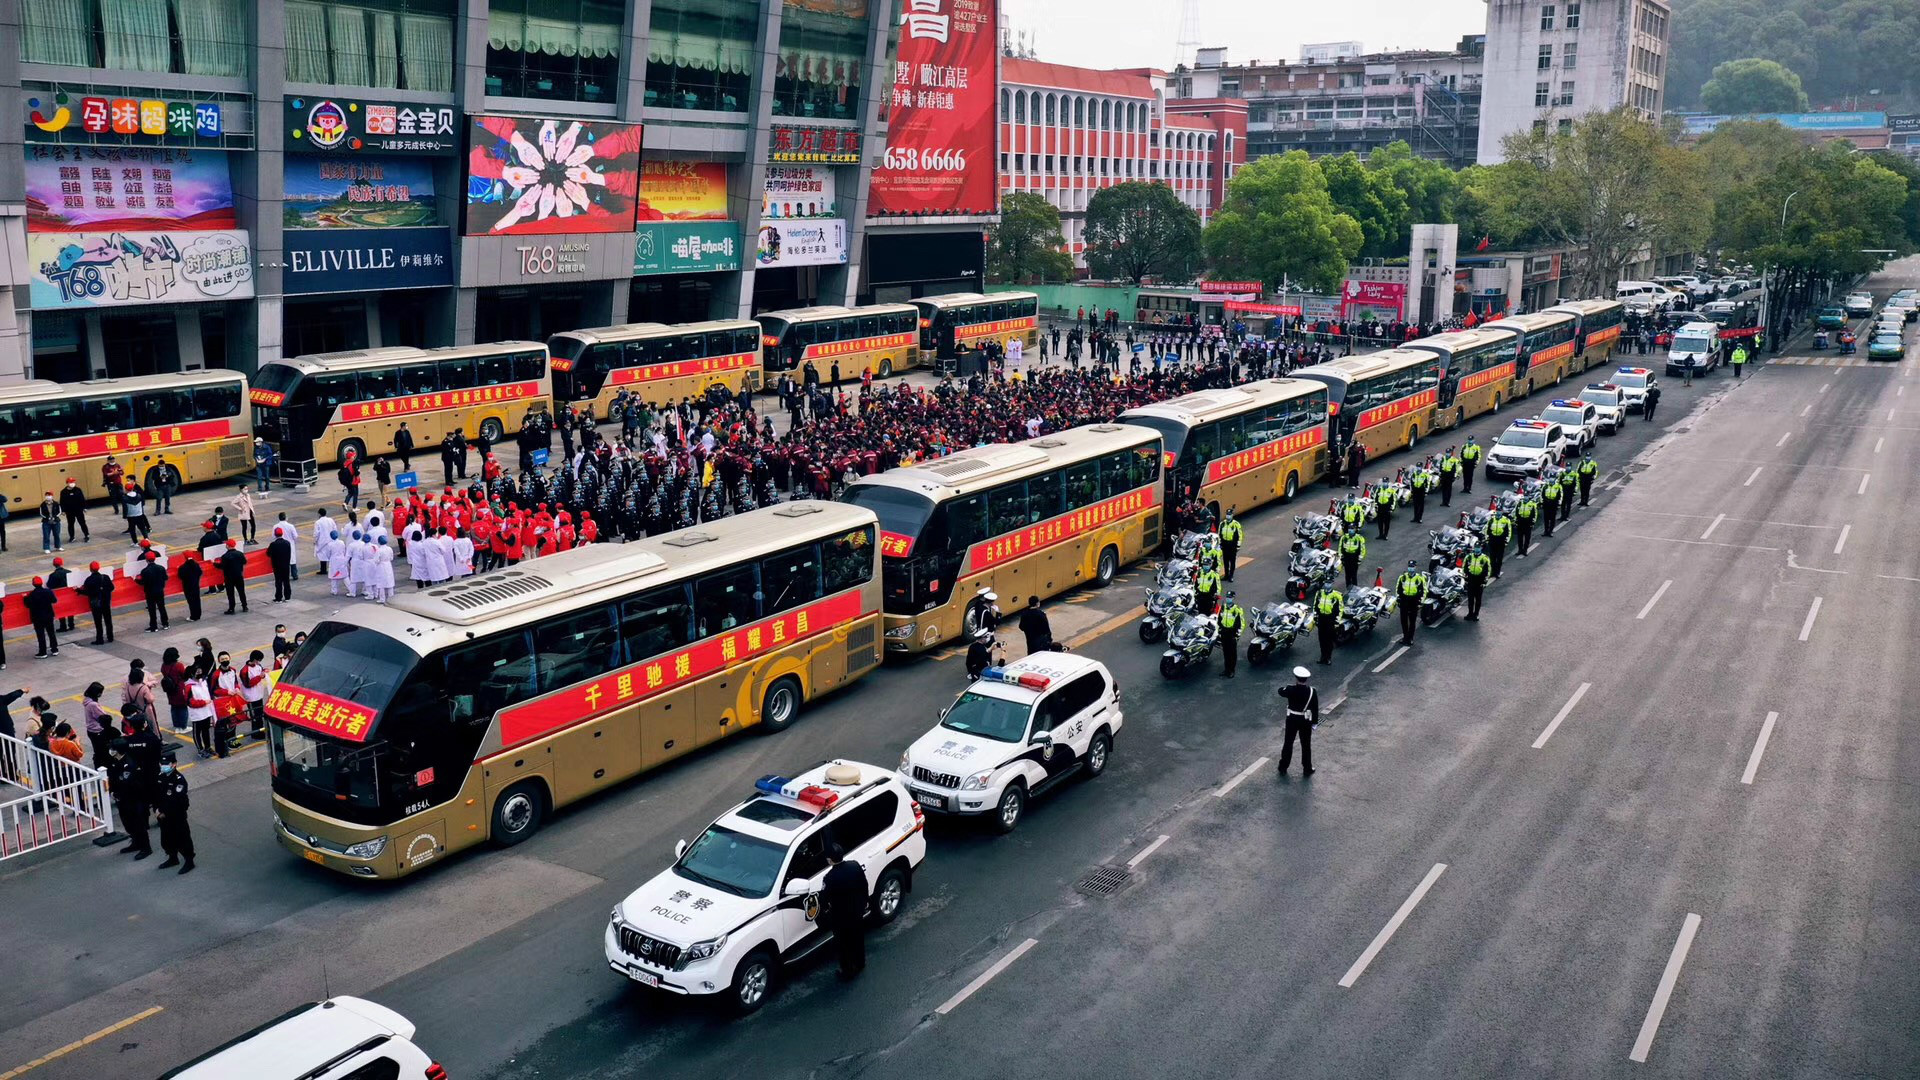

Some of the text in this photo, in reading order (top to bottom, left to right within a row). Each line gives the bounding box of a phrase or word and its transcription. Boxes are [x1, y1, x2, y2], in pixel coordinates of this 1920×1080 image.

[83, 99, 218, 132] 孕味妈咪购
[397, 107, 454, 135] 金宝贝
[381, 140, 440, 150] 儿童多元成长中心
[775, 128, 859, 153] 东方超市
[883, 146, 966, 171] 658 6666
[59, 166, 171, 181] 富强 民主 文明 和谐
[61, 181, 172, 195] 自由 平等 公正 法治
[64, 195, 174, 208] 爱国 敬业 诚信 友善
[516, 243, 590, 275] T68 AMUSING
[558, 254, 576, 263] MALL
[672, 235, 734, 260] 喵屋咖啡
[291, 248, 395, 272] ELIVILLE
[400, 253, 444, 267] 伊莉维尔
[50, 264, 106, 303] T68
[105, 427, 182, 449] 福耀宜昌
[584, 610, 809, 711] 千里驰援 福耀宜昌
[265, 689, 368, 737] 致敬最美逆行者
[1066, 720, 1084, 740] 公安
[932, 748, 968, 761] POLICE
[667, 889, 715, 912] 警察
[650, 905, 692, 925] POLICE
